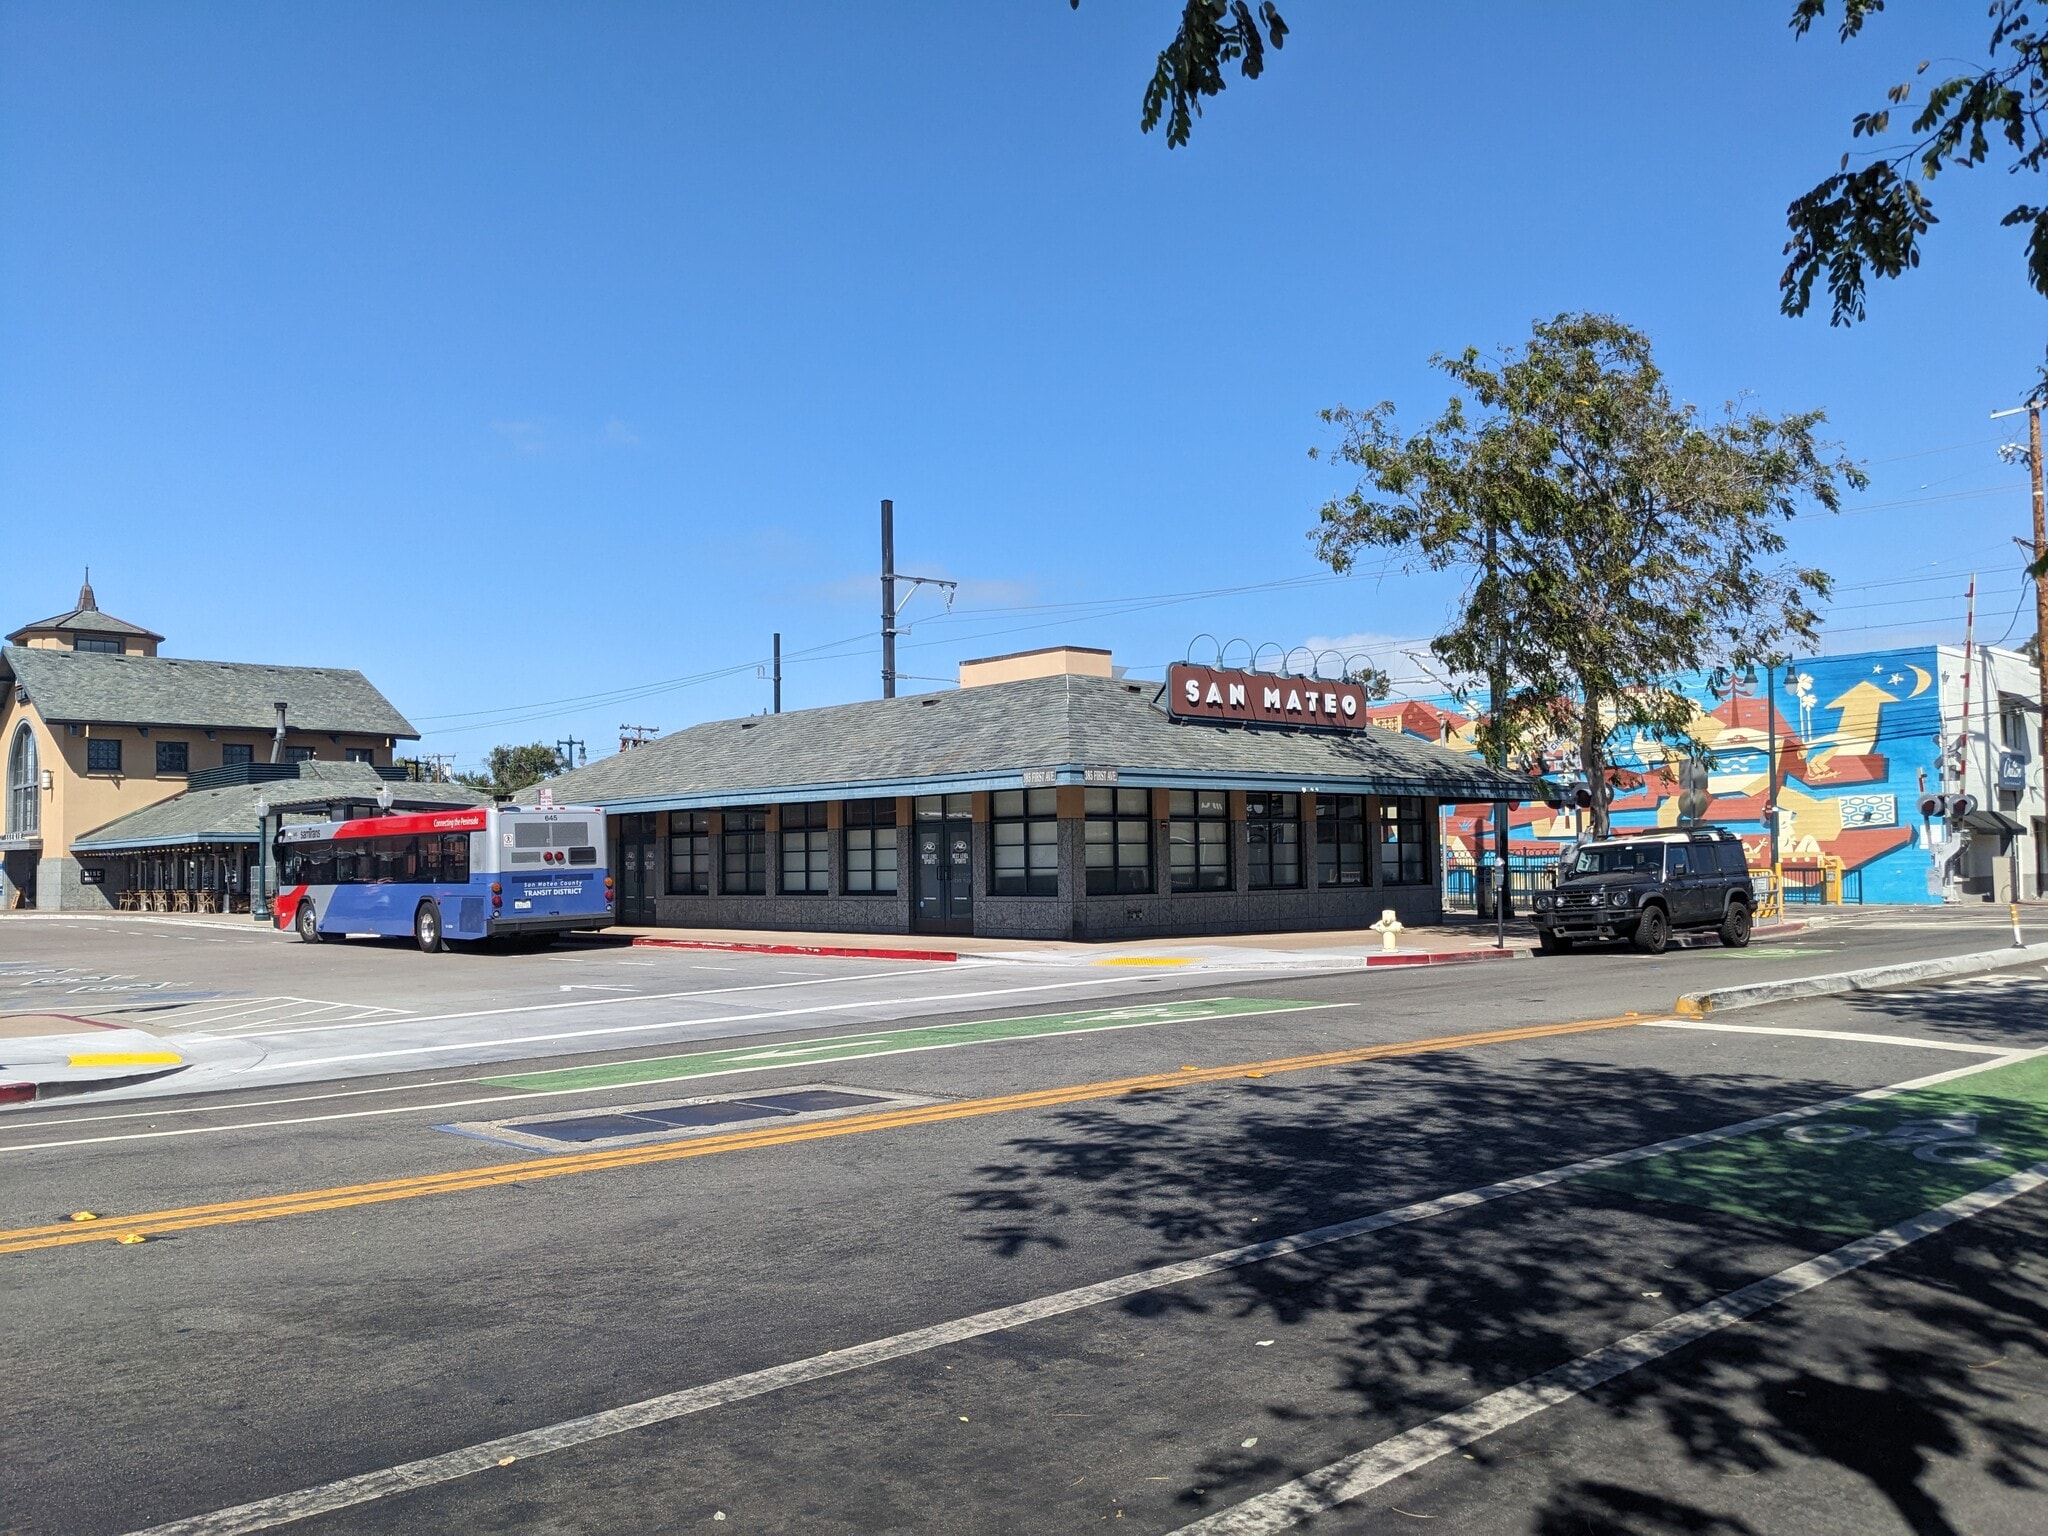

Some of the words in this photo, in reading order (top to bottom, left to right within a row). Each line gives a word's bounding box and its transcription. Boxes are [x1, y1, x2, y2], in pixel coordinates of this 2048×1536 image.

[1185, 679, 1245, 706] SAN
[1263, 686, 1357, 716] MATEO
[1031, 771, 1045, 783] FIRST
[1093, 770, 1107, 782] FIRST
[433, 818, 454, 829] Connecting
[544, 814, 558, 822] 645
[560, 879, 583, 888] County
[523, 889, 552, 897] TRANSIT
[553, 887, 583, 896] DISTRICT
